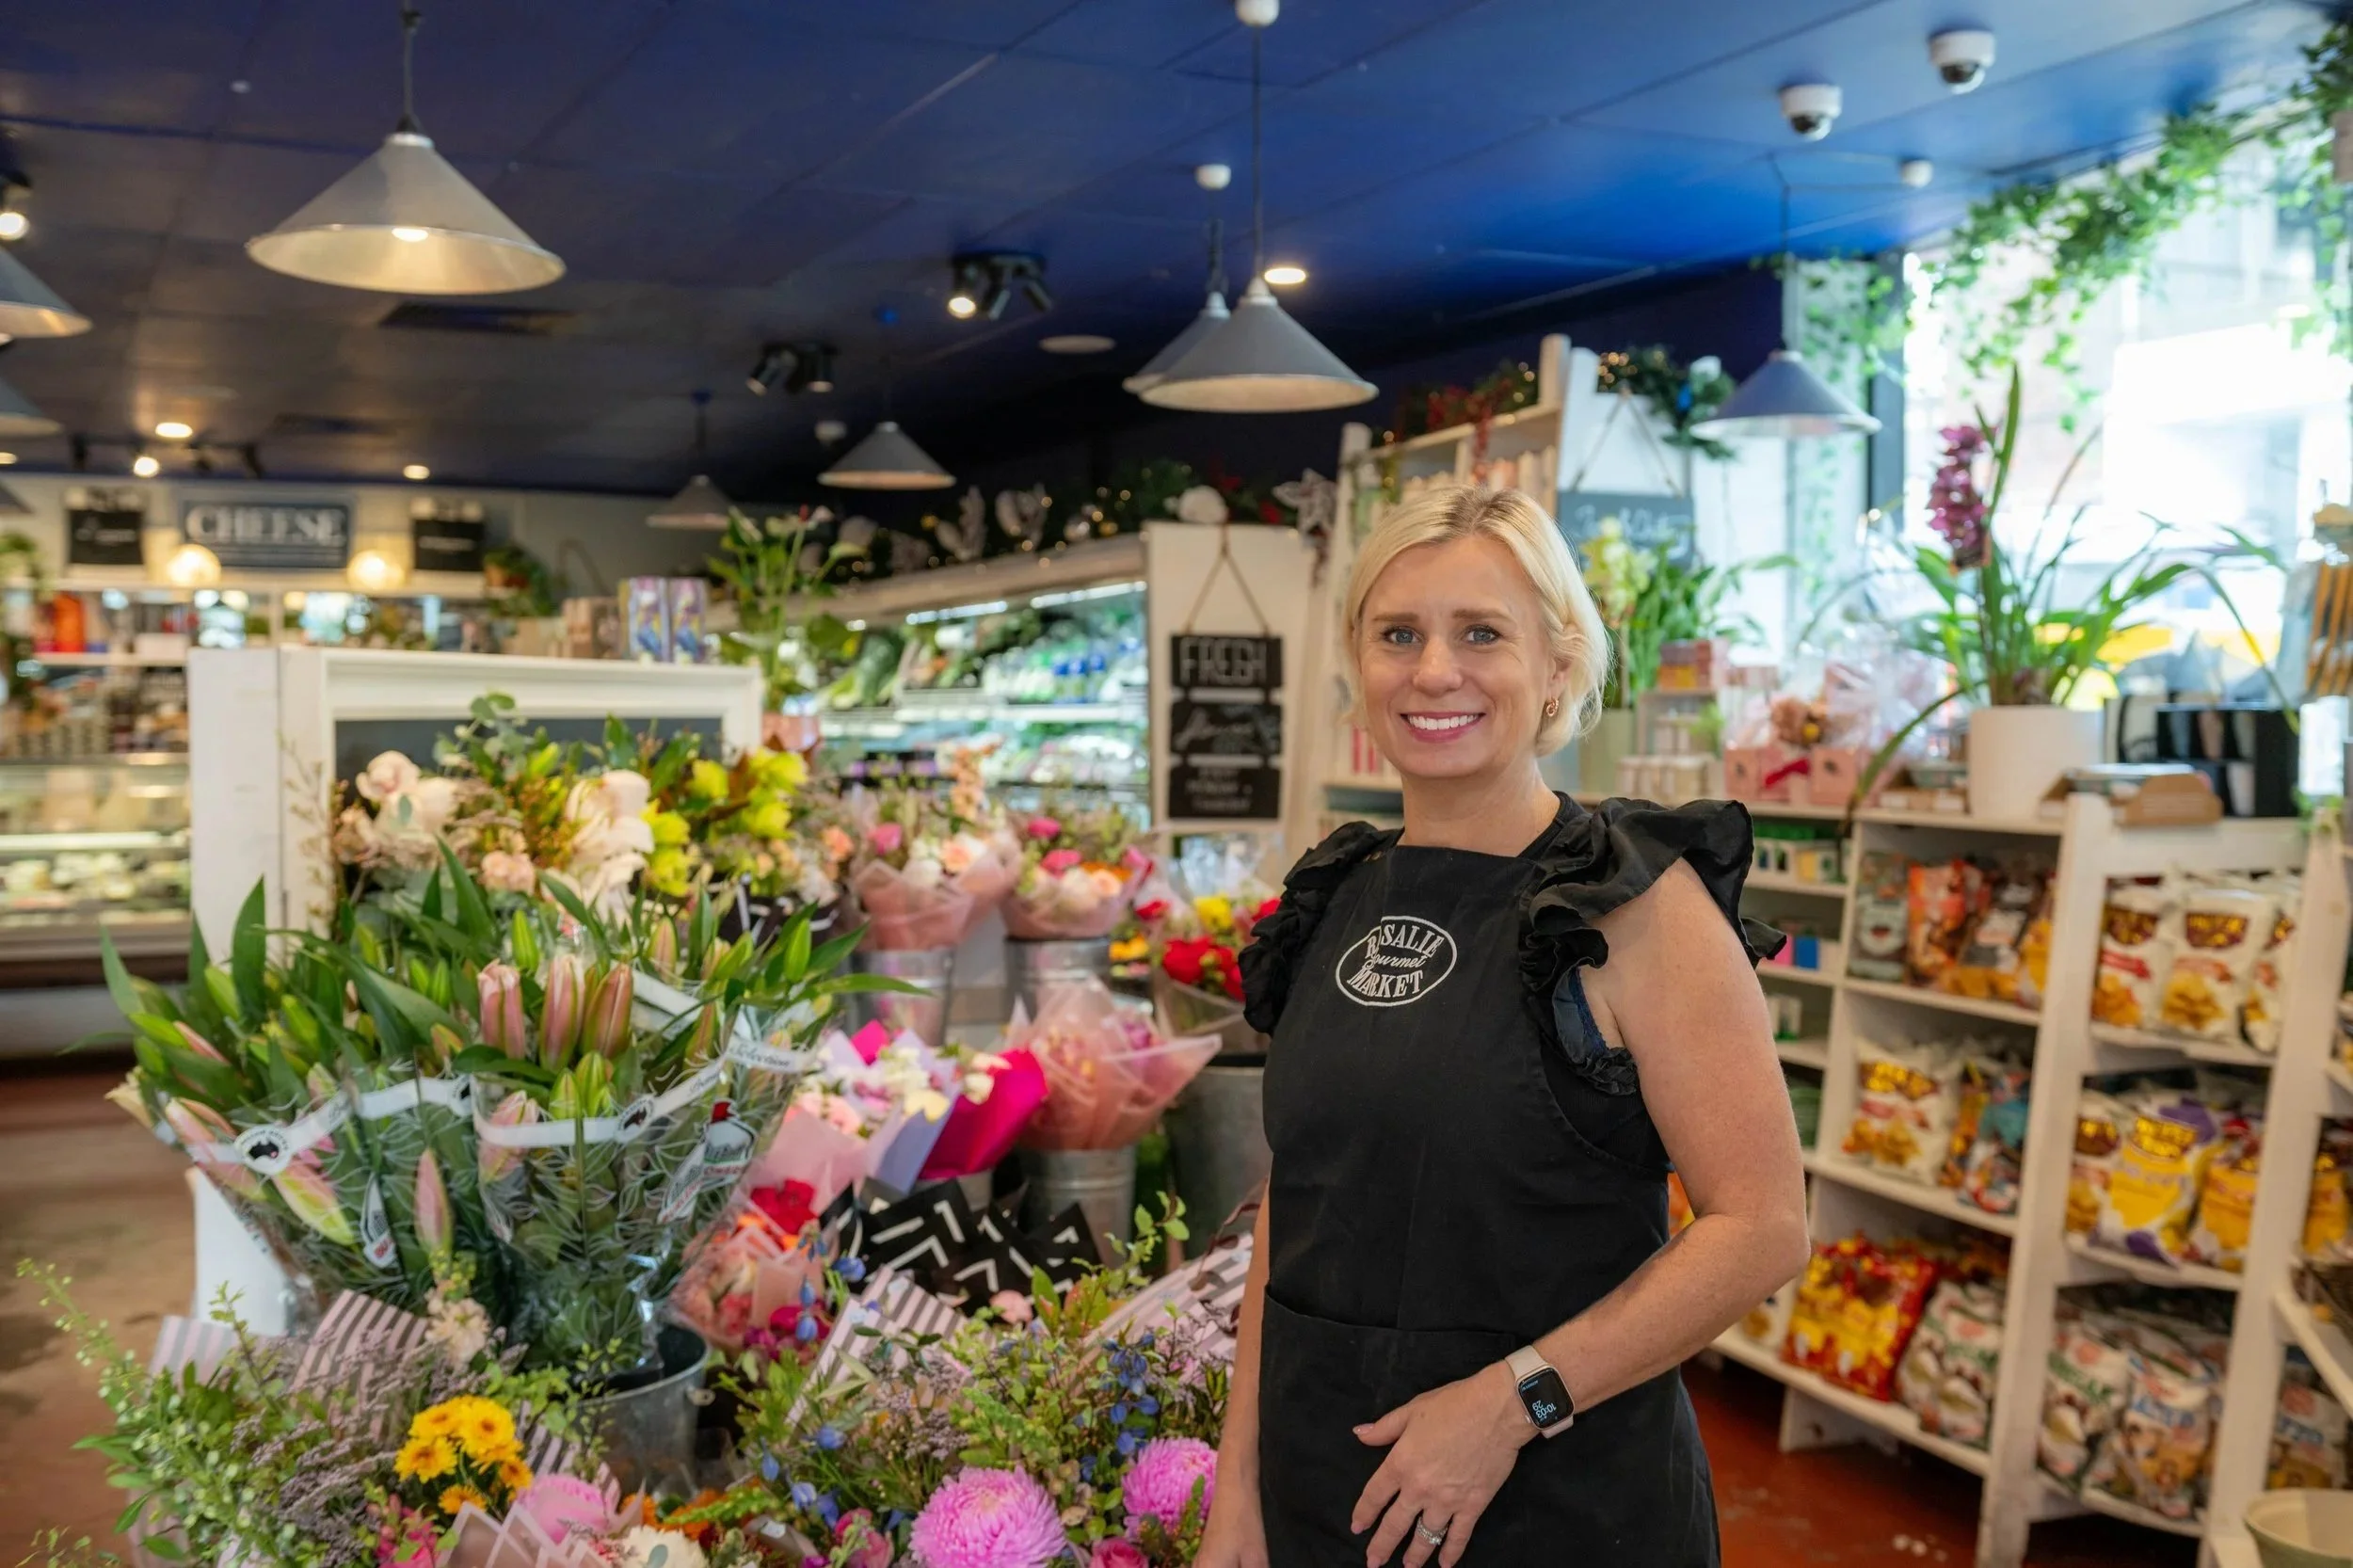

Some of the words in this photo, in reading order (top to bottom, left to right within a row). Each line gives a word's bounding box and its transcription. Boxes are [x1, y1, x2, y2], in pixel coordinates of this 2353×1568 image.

[186, 506, 345, 546] CHEESE
[1532, 1400, 1544, 1411] 29
[1536, 1402, 1557, 1418] 10:03
